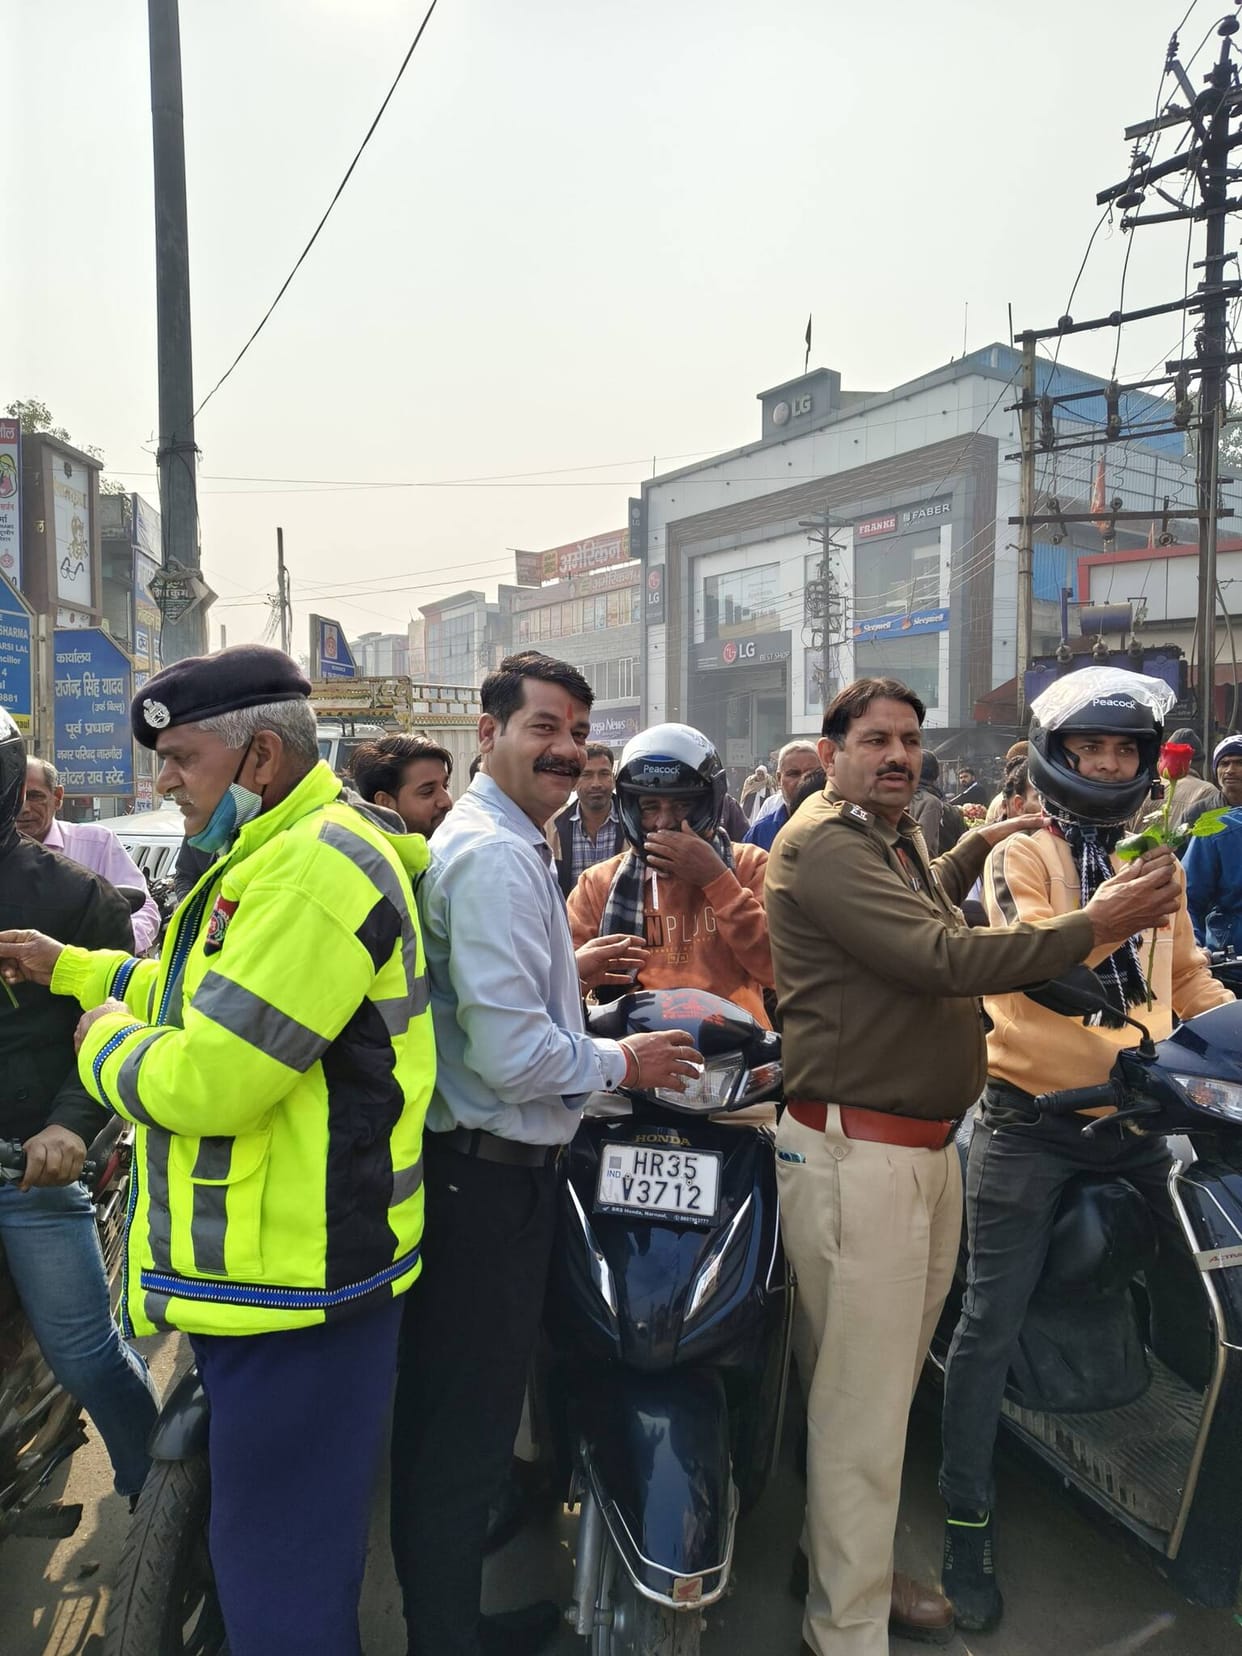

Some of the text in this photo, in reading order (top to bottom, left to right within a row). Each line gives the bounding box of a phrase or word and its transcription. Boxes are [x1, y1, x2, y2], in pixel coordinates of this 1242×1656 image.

[791, 393, 811, 417] LG
[911, 503, 951, 519] FABER
[859, 518, 896, 534] FRANKE
[648, 592, 660, 604] LG
[0, 625, 29, 640] SHARMA
[15, 643, 29, 653] LAL
[56, 648, 92, 664] कार्यालय
[739, 642, 756, 658] LG
[1, 668, 8, 676] 4
[55, 672, 81, 700] राजेन्द्र
[82, 671, 101, 698] सिंह
[102, 677, 124, 696] यादव
[1092, 698, 1137, 710] Peacock
[65, 719, 115, 739] पूर्व प्रधान
[605, 717, 626, 731] News
[87, 770, 103, 785] राव
[104, 765, 125, 785] स्टेट
[643, 764, 681, 774] Peacock
[634, 1134, 692, 1147] HONDA
[606, 1169, 621, 1178] IND
[633, 1151, 698, 1181] HR35
[622, 1176, 701, 1210] V3712
